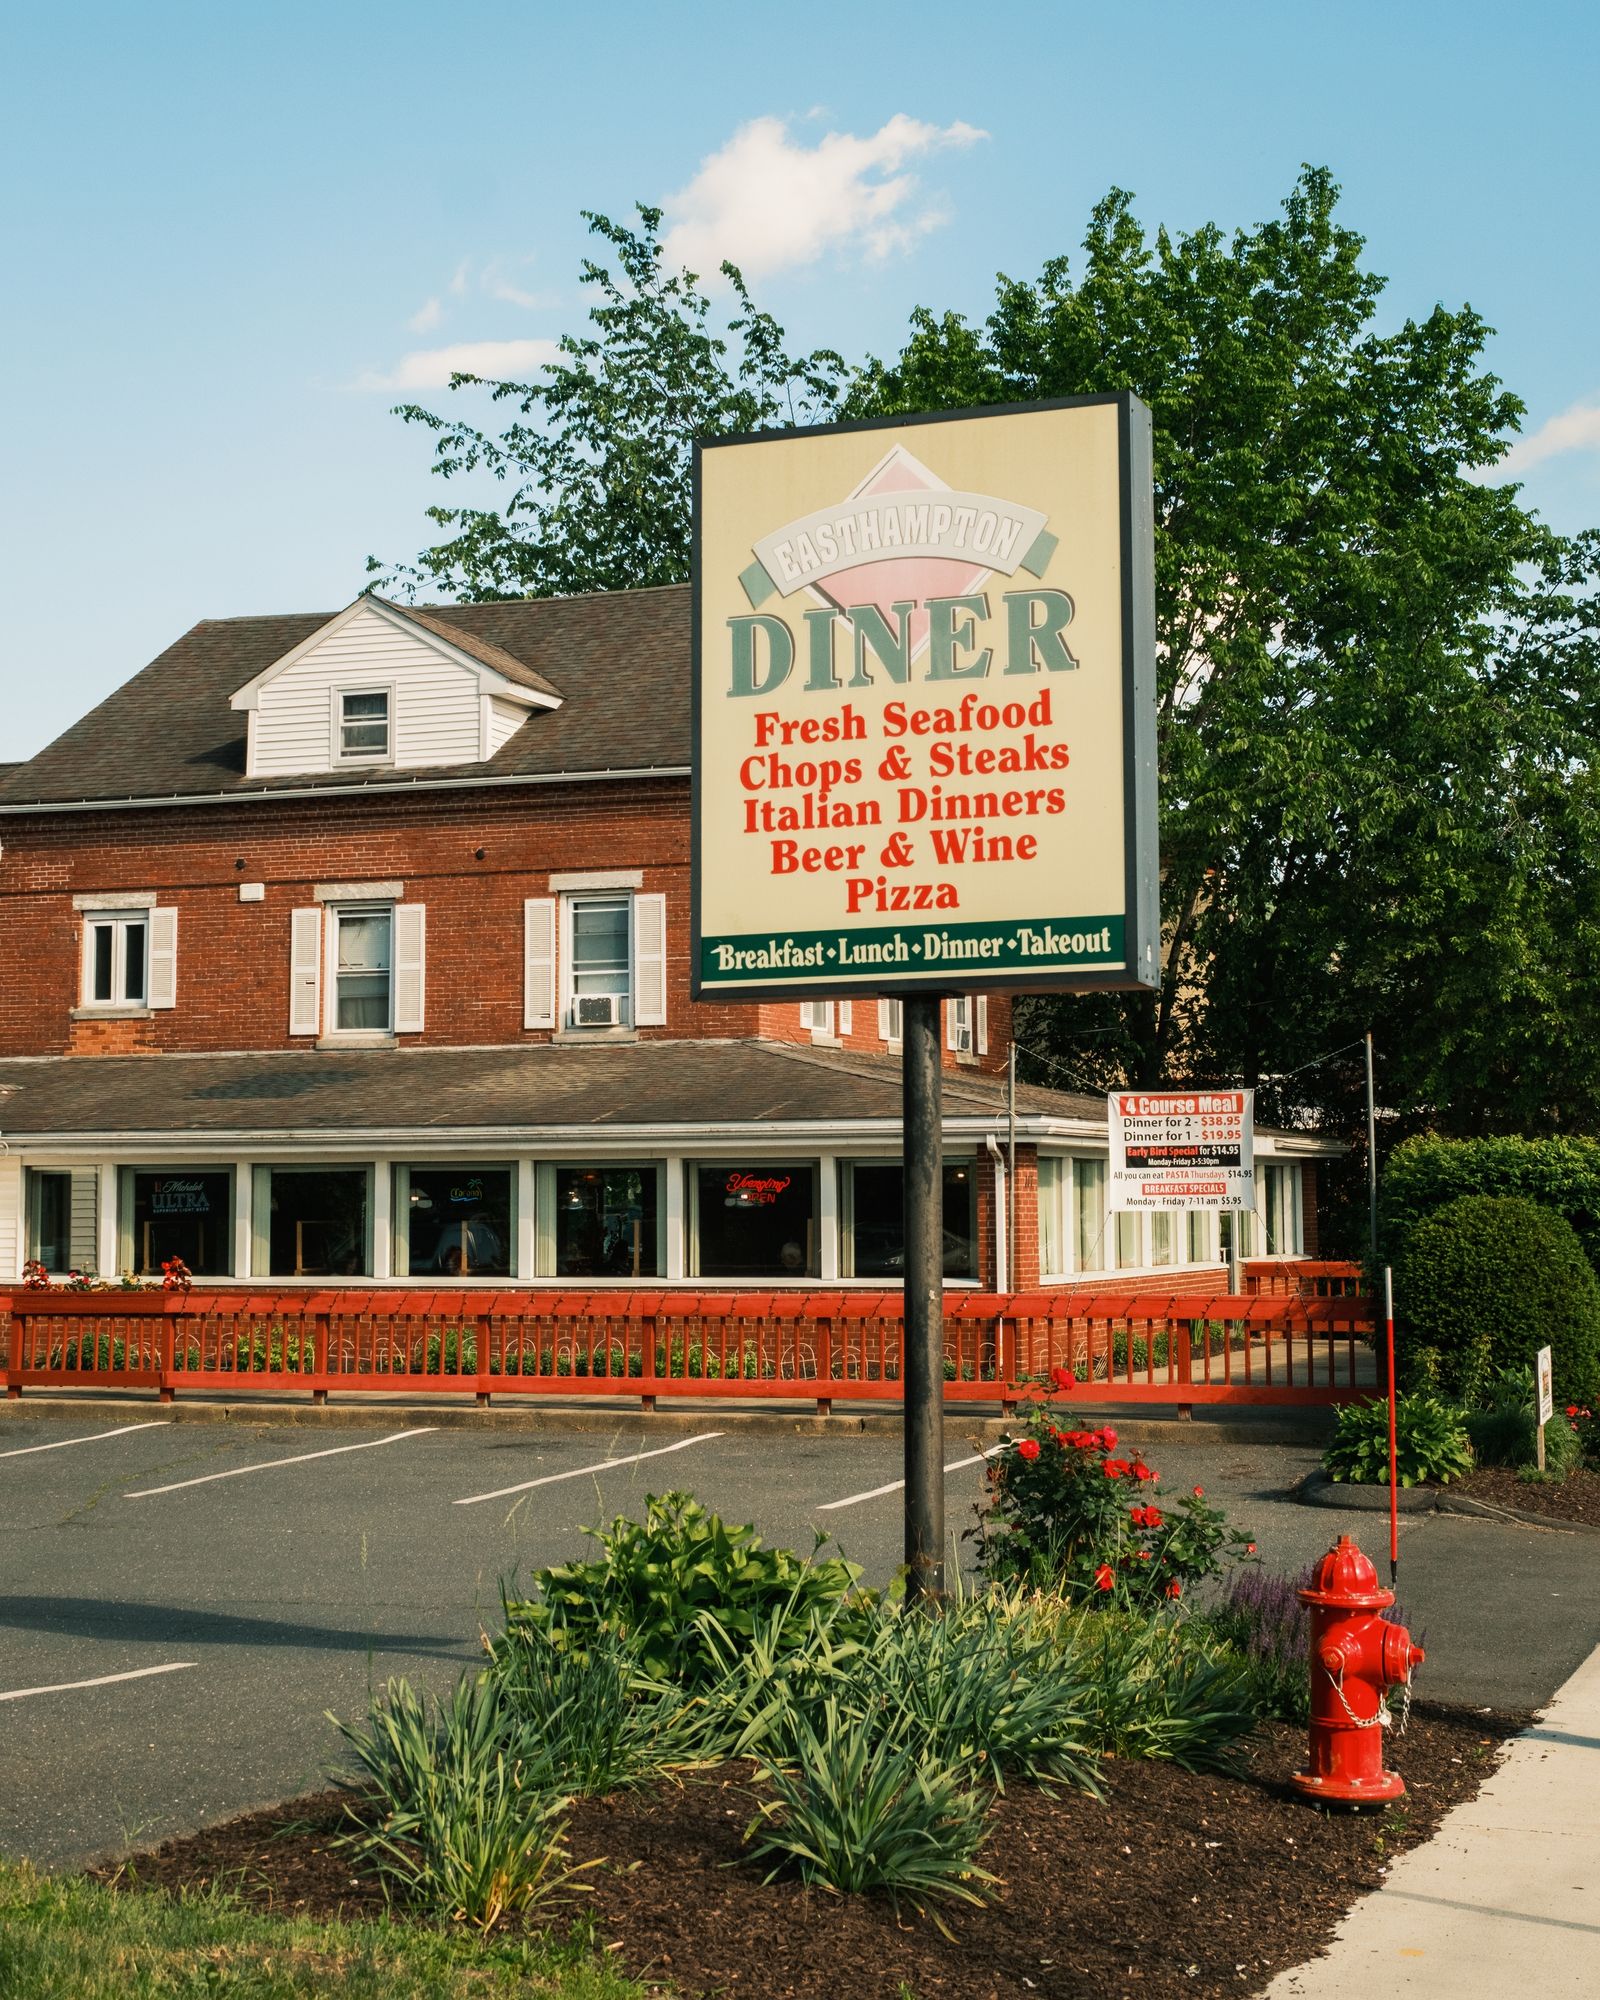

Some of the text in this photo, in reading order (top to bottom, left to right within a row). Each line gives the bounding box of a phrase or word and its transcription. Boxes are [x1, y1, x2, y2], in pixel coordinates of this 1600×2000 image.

[774, 504, 1024, 583] EASTHAMPTON
[726, 588, 1080, 697] DINER
[755, 689, 1053, 747] Fresh Seafood
[739, 733, 1070, 803] Chops & Steaks
[743, 784, 1066, 833] Italian Dinners
[770, 826, 1038, 875] Beer & Wine
[845, 875, 960, 914] Pizza
[1125, 1095, 1237, 1114] 4 Course Meal
[1124, 1117, 1163, 1128] Dinner
[1165, 1116, 1182, 1127] for
[1185, 1117, 1192, 1127] 2
[1201, 1115, 1241, 1127] $38.95
[1124, 1131, 1163, 1142] Dinner
[1166, 1130, 1182, 1141] for
[1186, 1131, 1191, 1140] 1
[1202, 1130, 1242, 1141] $19.95
[1127, 1145, 1239, 1157] Early Bird Special for $14.95
[1148, 1158, 1190, 1166] Monday-Friday
[1114, 1172, 1123, 1180] All
[1124, 1173, 1138, 1181] you
[1165, 1170, 1189, 1179] PASTA
[1191, 1170, 1225, 1181] Thursdays
[1228, 1169, 1253, 1179] $14.95
[1144, 1183, 1225, 1194] BREAKFAST SPECIALS
[152, 1192, 209, 1208] ULTRA
[1126, 1198, 1157, 1207] Monday
[1162, 1197, 1186, 1207] Friday
[1188, 1197, 1204, 1206] 7-11
[1205, 1198, 1219, 1206] am
[1221, 1196, 1242, 1206] $5.95
